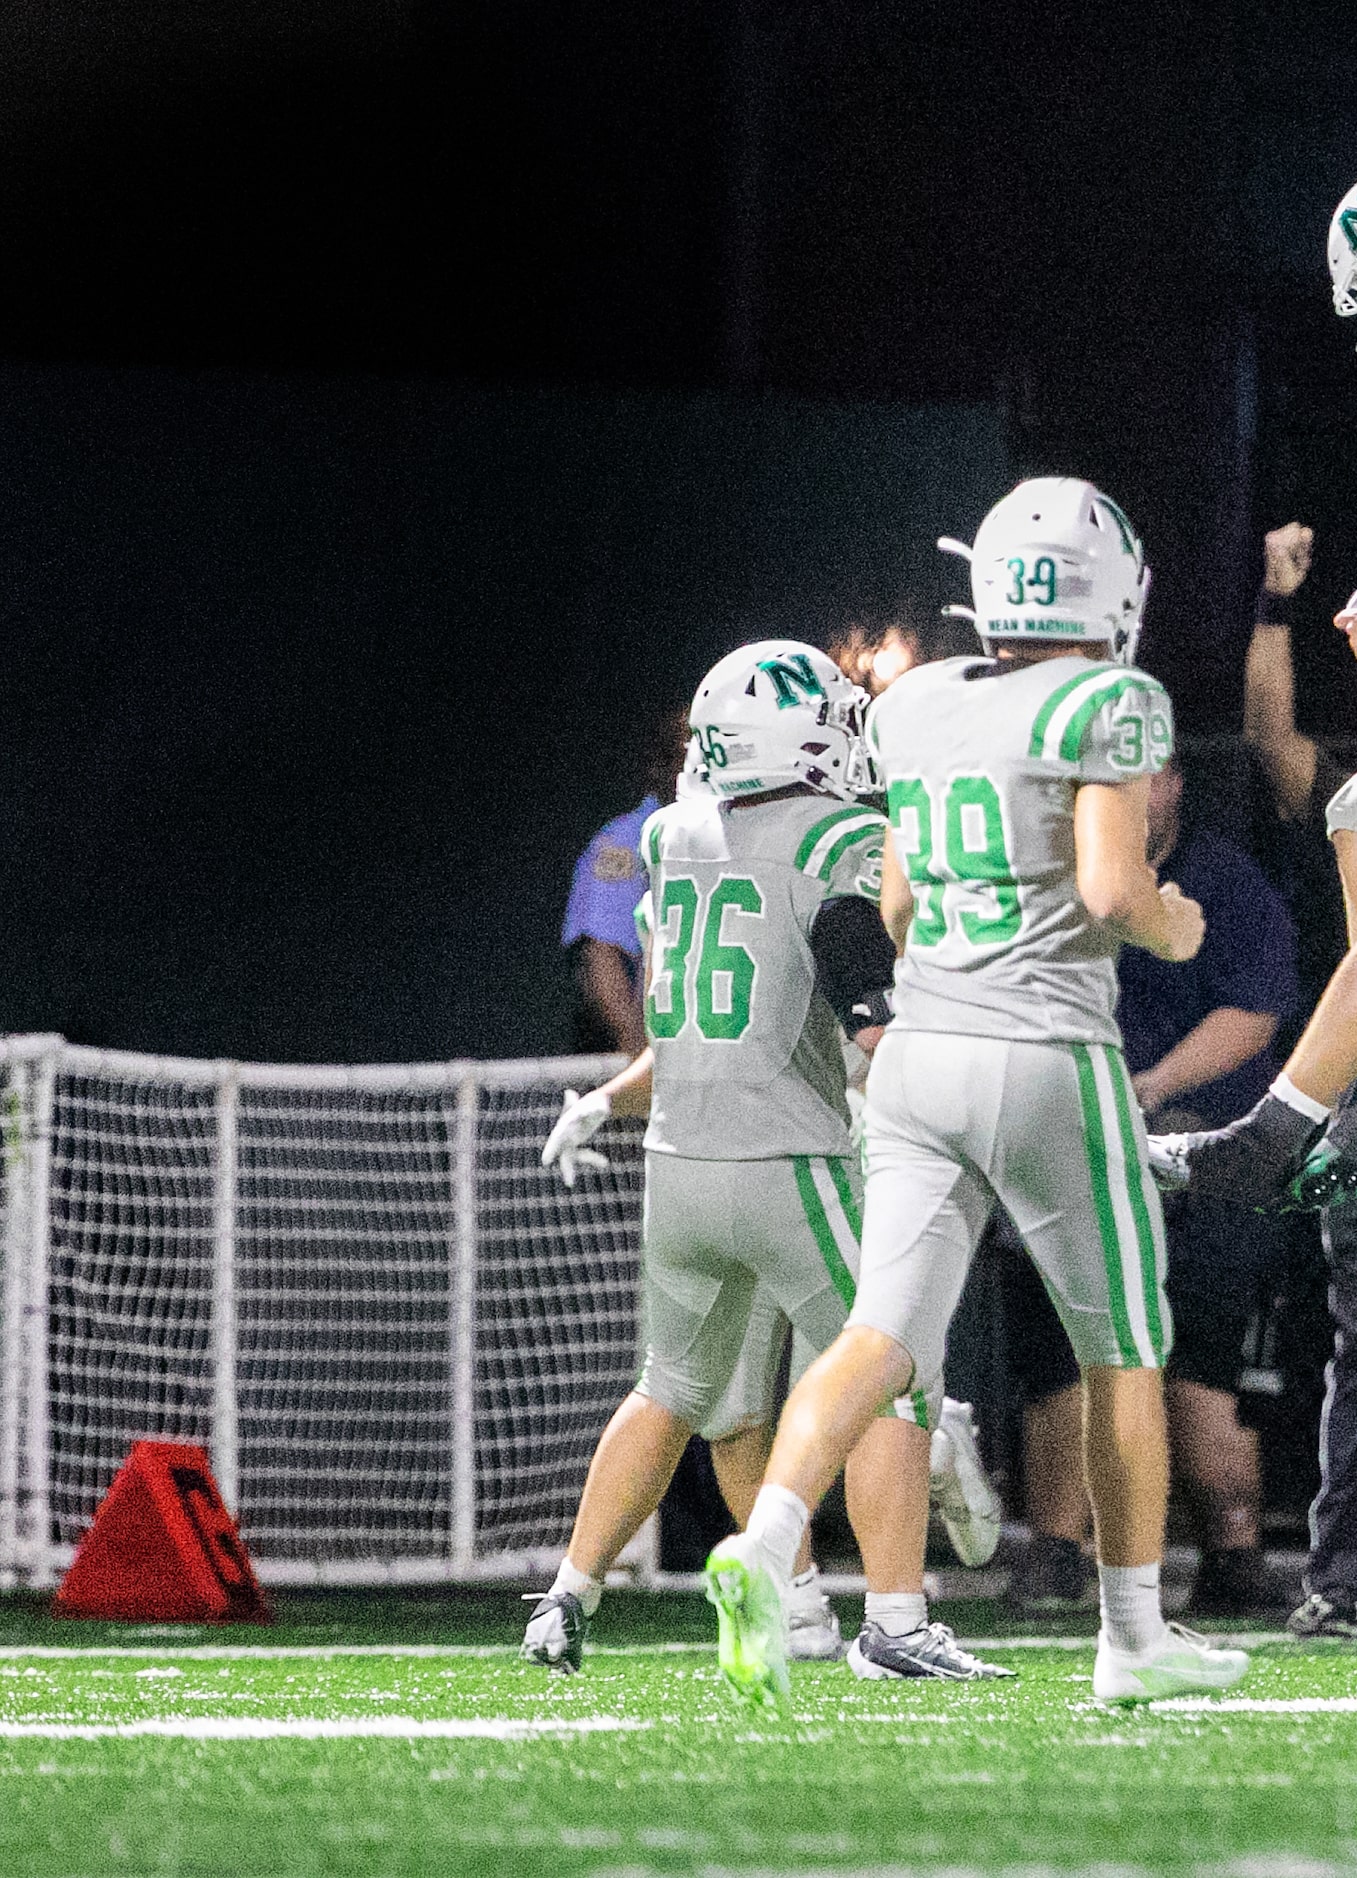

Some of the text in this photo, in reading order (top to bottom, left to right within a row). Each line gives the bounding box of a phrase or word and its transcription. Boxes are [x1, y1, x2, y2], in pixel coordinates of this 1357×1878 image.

[1006, 556, 1056, 605] 39
[756, 653, 826, 710] N
[1106, 709, 1173, 773] 39
[887, 771, 1026, 948] 39
[645, 871, 765, 1043] 36
